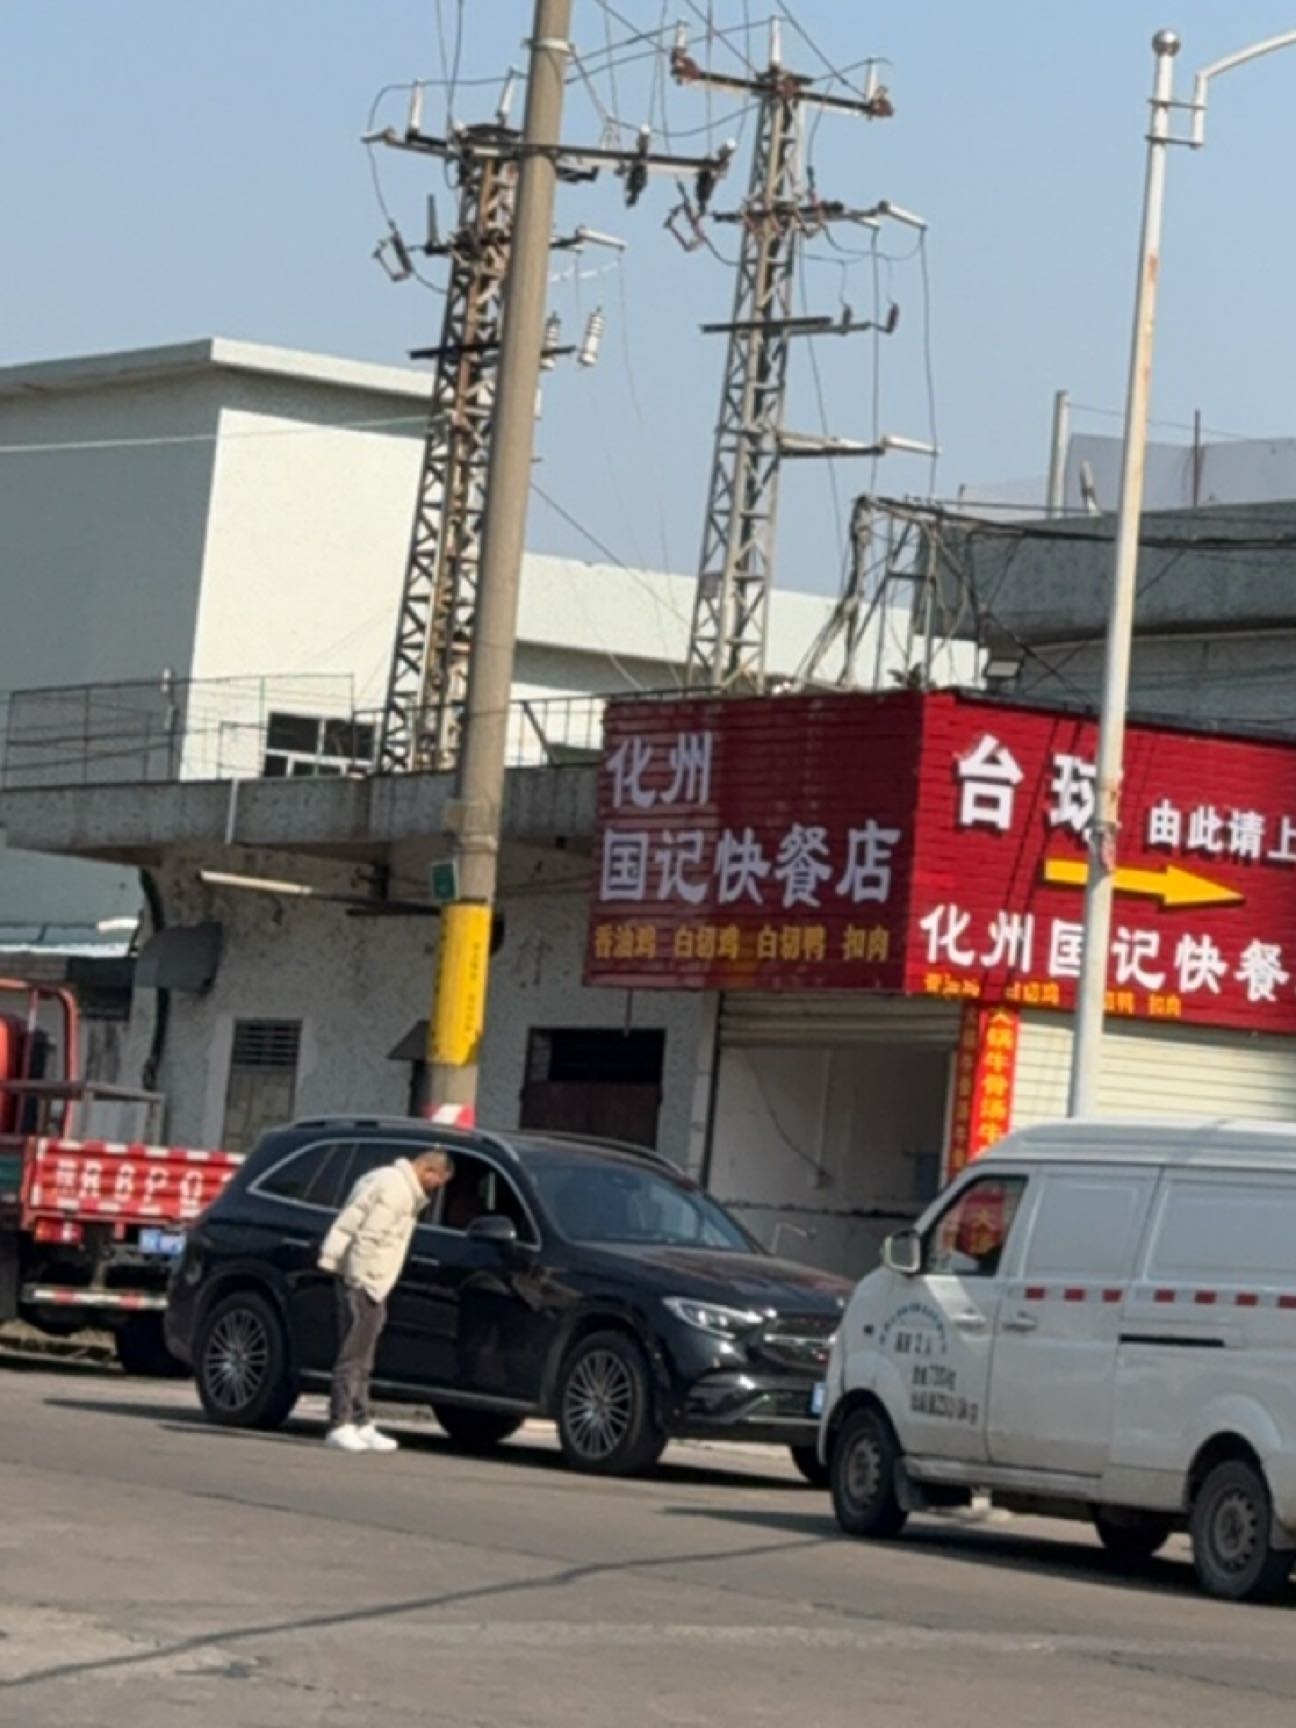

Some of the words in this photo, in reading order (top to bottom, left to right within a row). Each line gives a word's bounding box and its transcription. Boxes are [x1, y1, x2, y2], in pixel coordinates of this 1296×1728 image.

[605, 730, 713, 808] 化州
[600, 819, 901, 908] 国记快餐店
